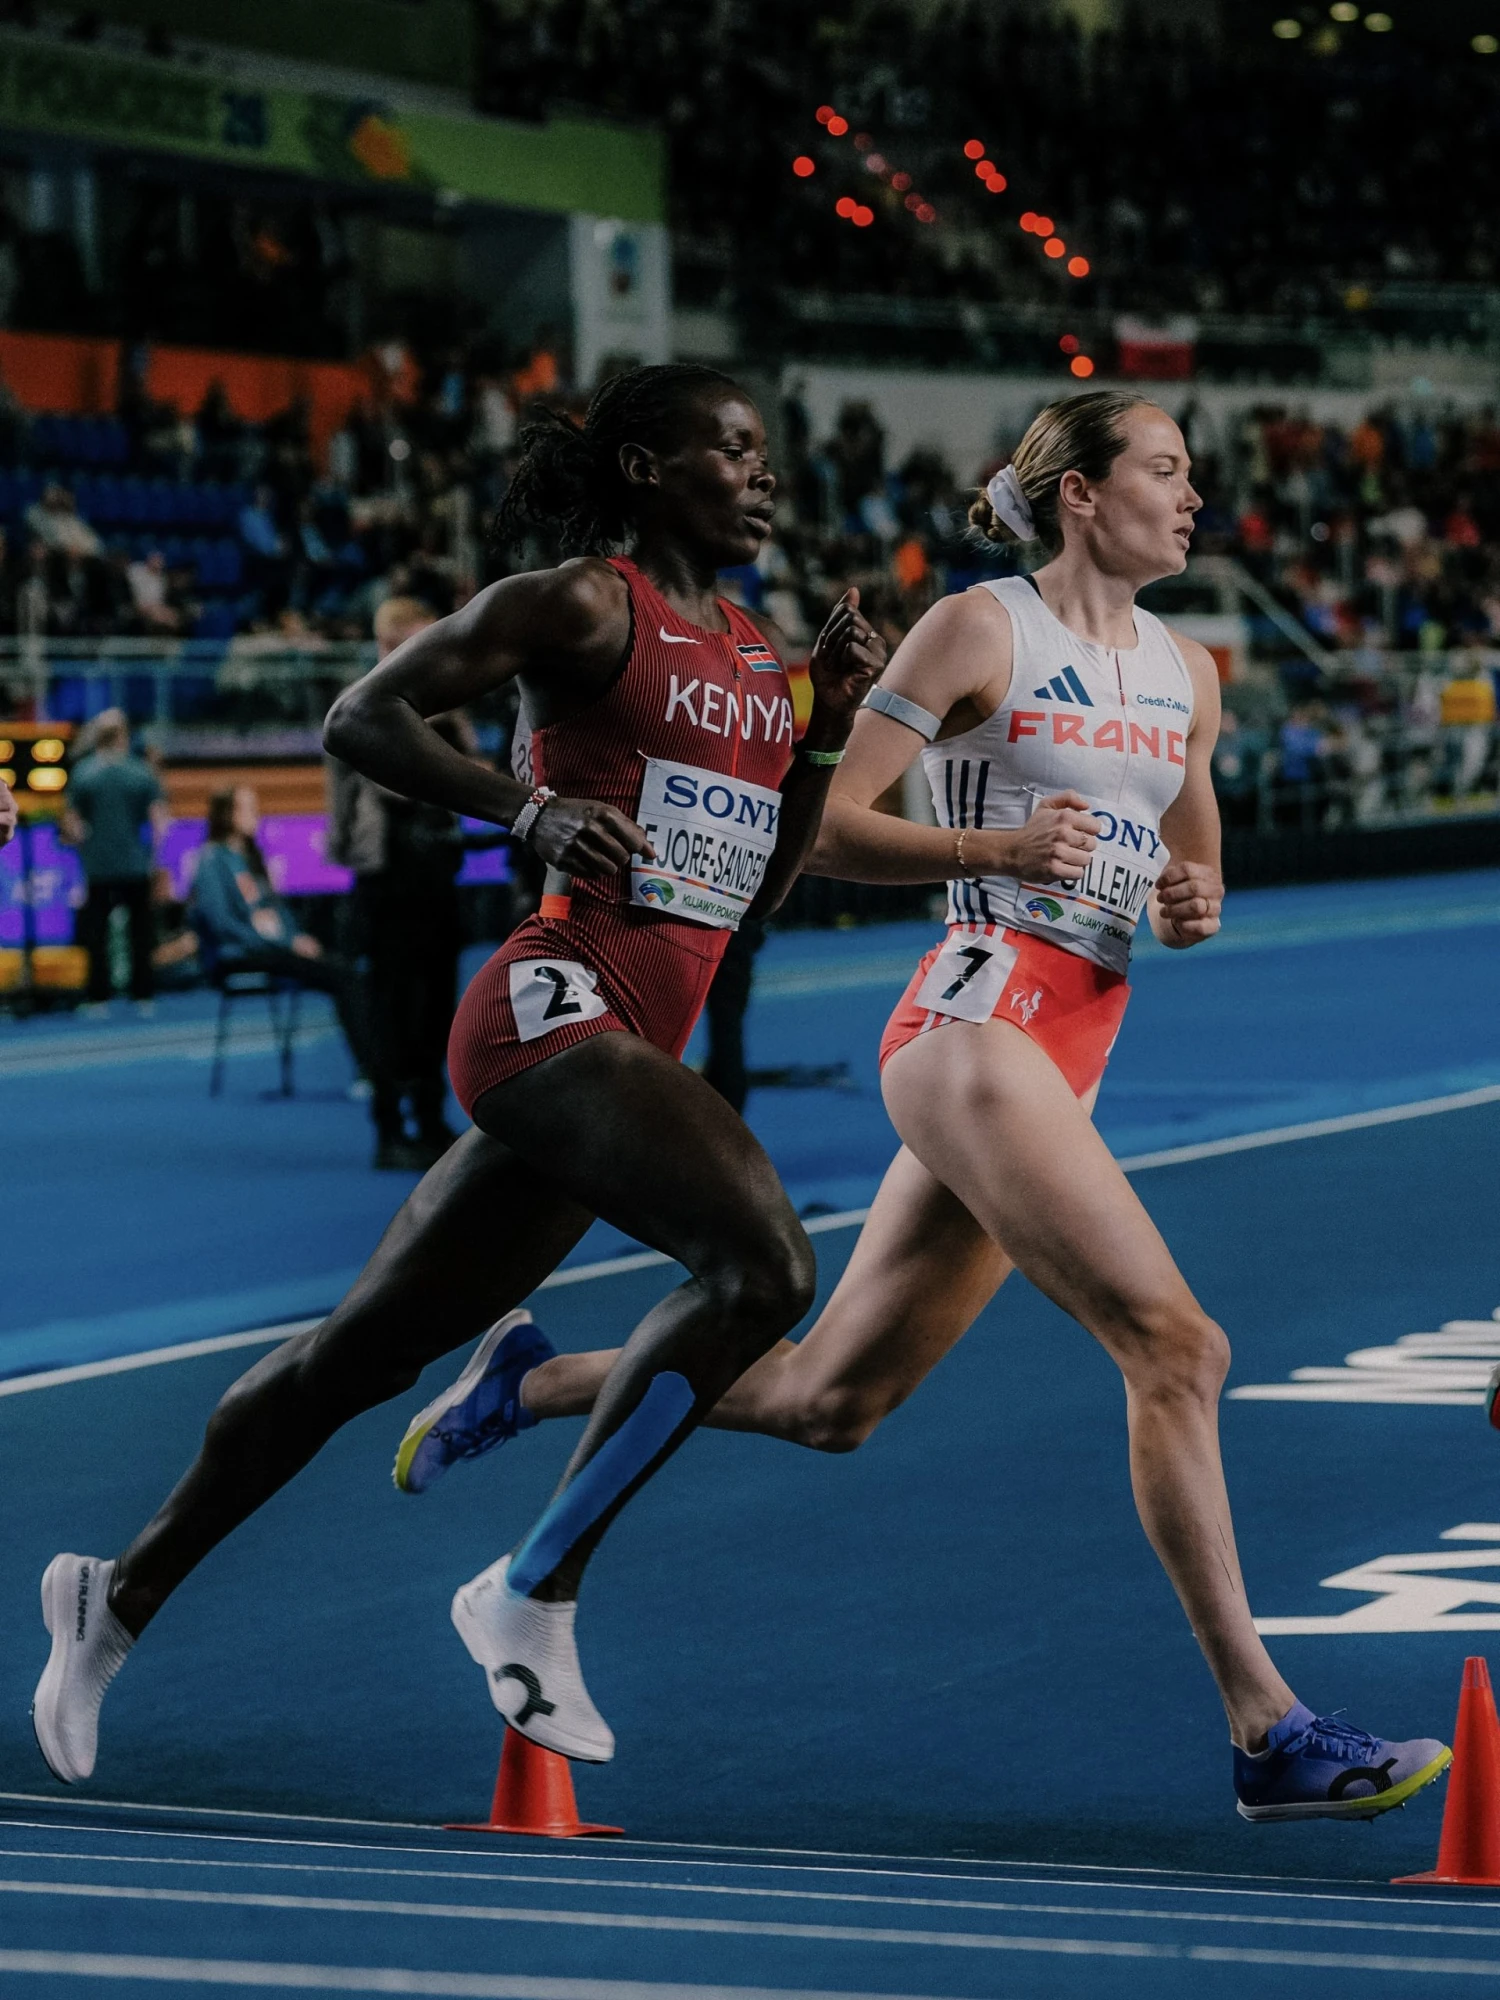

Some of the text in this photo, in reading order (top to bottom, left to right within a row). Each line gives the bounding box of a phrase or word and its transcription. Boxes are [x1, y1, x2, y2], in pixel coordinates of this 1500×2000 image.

[665, 674, 793, 747] KENYA
[1007, 710, 1184, 767] FRANC
[663, 775, 781, 835] SONY
[1091, 811, 1160, 859] ONY
[534, 966, 582, 1021] 2
[941, 945, 994, 1001] 7
